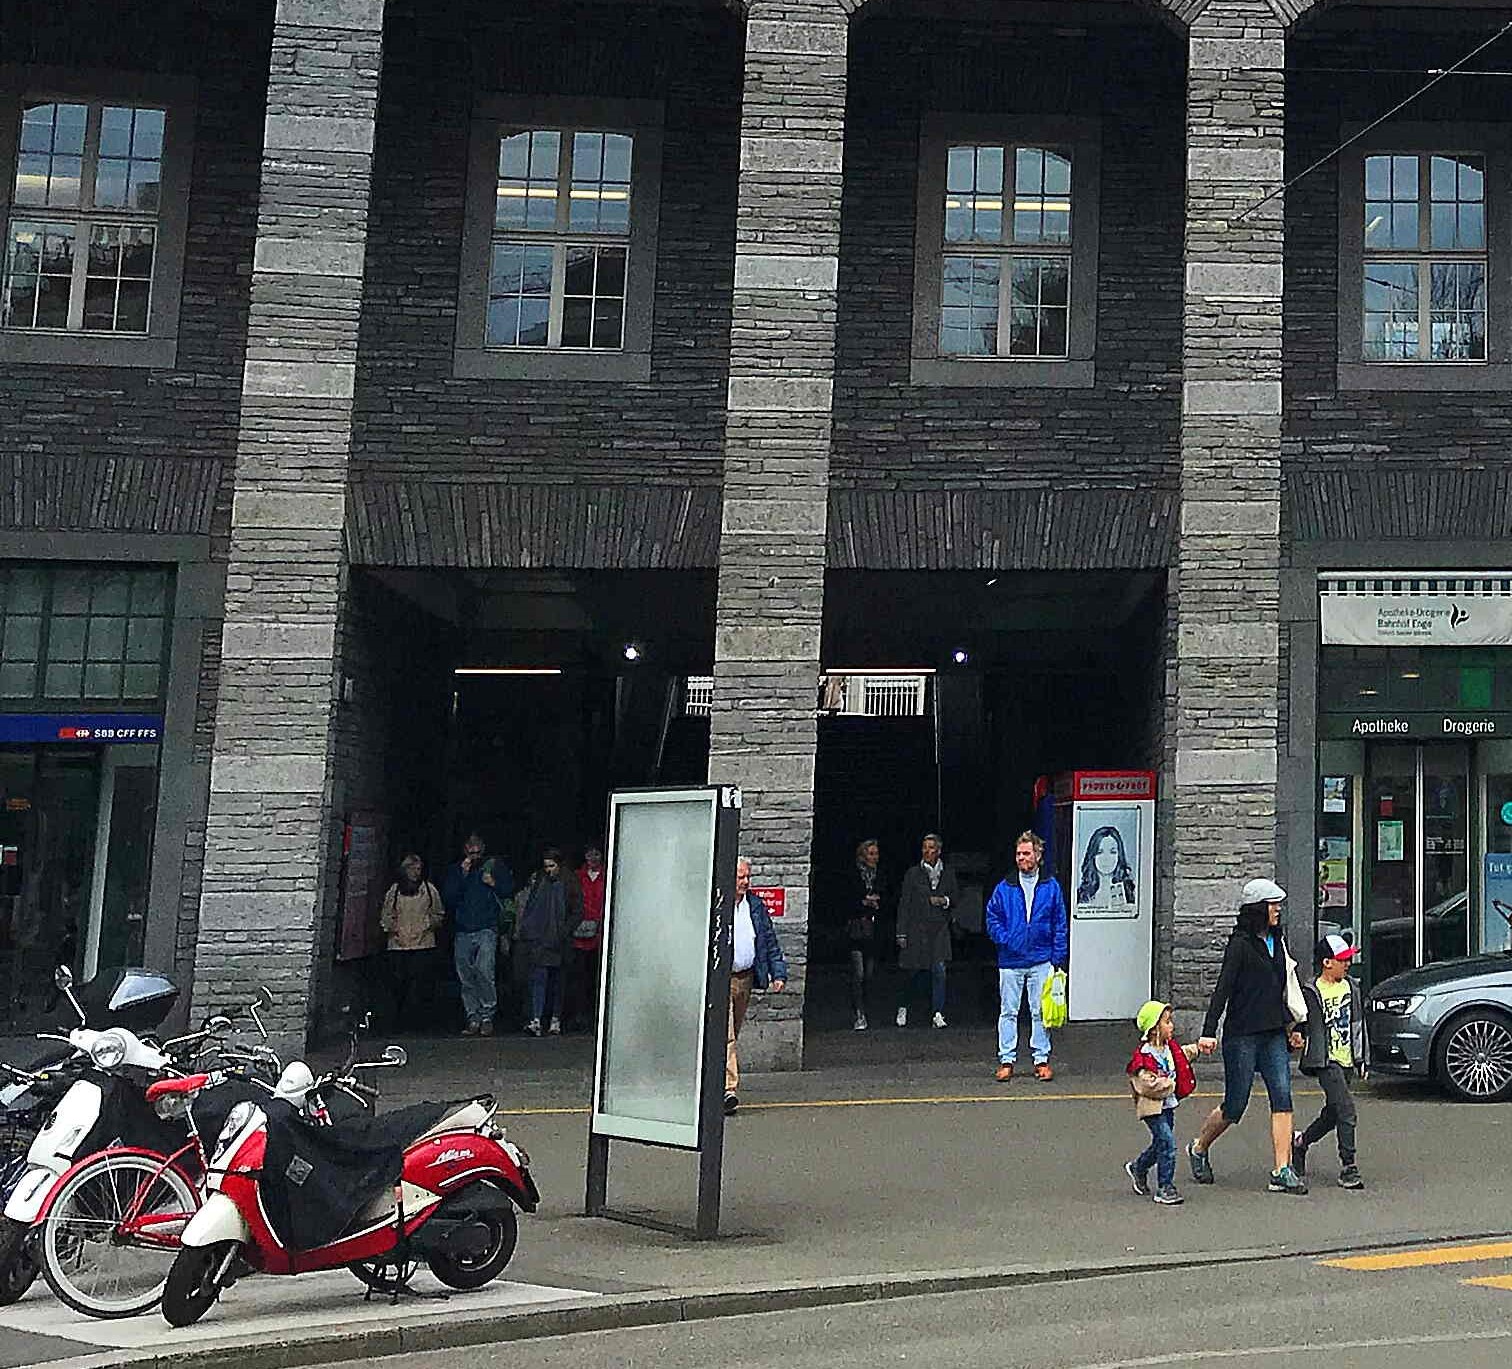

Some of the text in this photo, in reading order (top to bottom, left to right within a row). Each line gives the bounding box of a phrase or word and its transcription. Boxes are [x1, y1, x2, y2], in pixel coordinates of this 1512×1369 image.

[93, 728, 157, 738] SBB CFF FFS
[1352, 718, 1496, 735] Apotheke Drogerie
